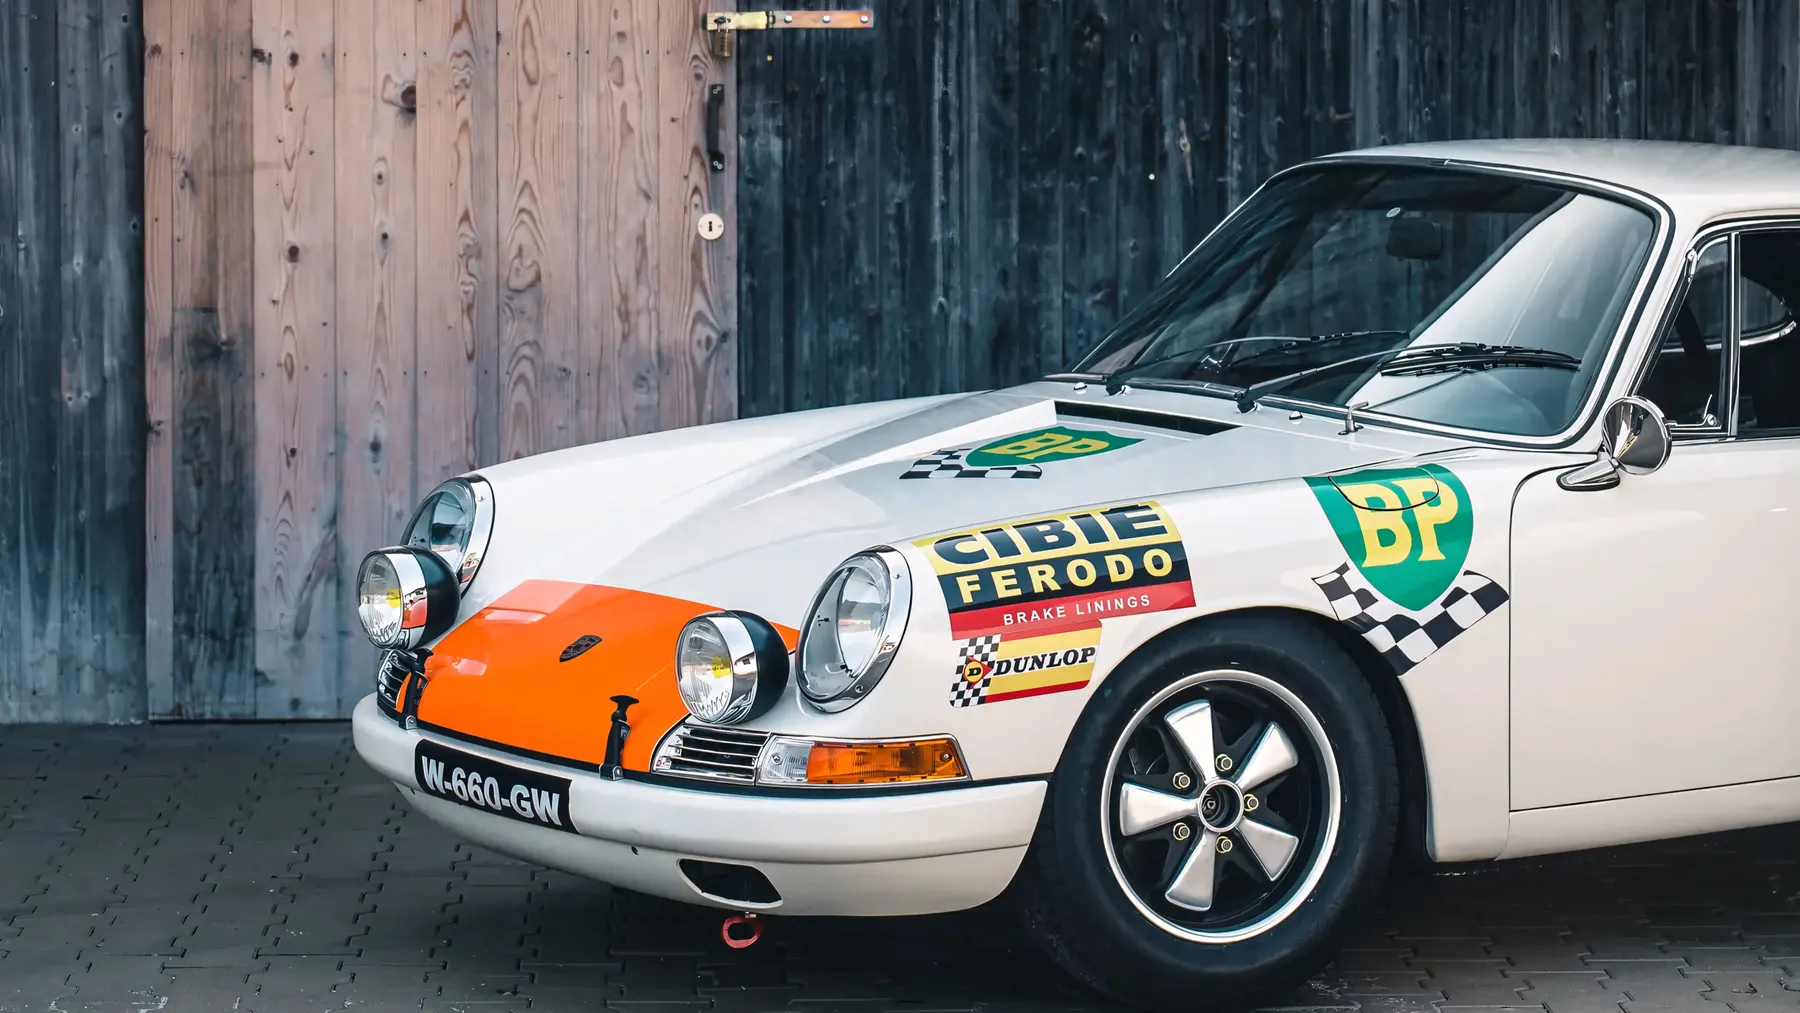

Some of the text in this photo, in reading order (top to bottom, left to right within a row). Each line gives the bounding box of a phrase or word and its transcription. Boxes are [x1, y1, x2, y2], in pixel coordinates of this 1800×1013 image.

[979, 432, 1110, 460] BP
[1333, 477, 1459, 568] BP
[955, 548, 1173, 604] FERODO
[1003, 594, 1151, 626] BRAKE LININGS
[966, 647, 1096, 677] D DUNLOP
[421, 755, 563, 826] W-660-GW
